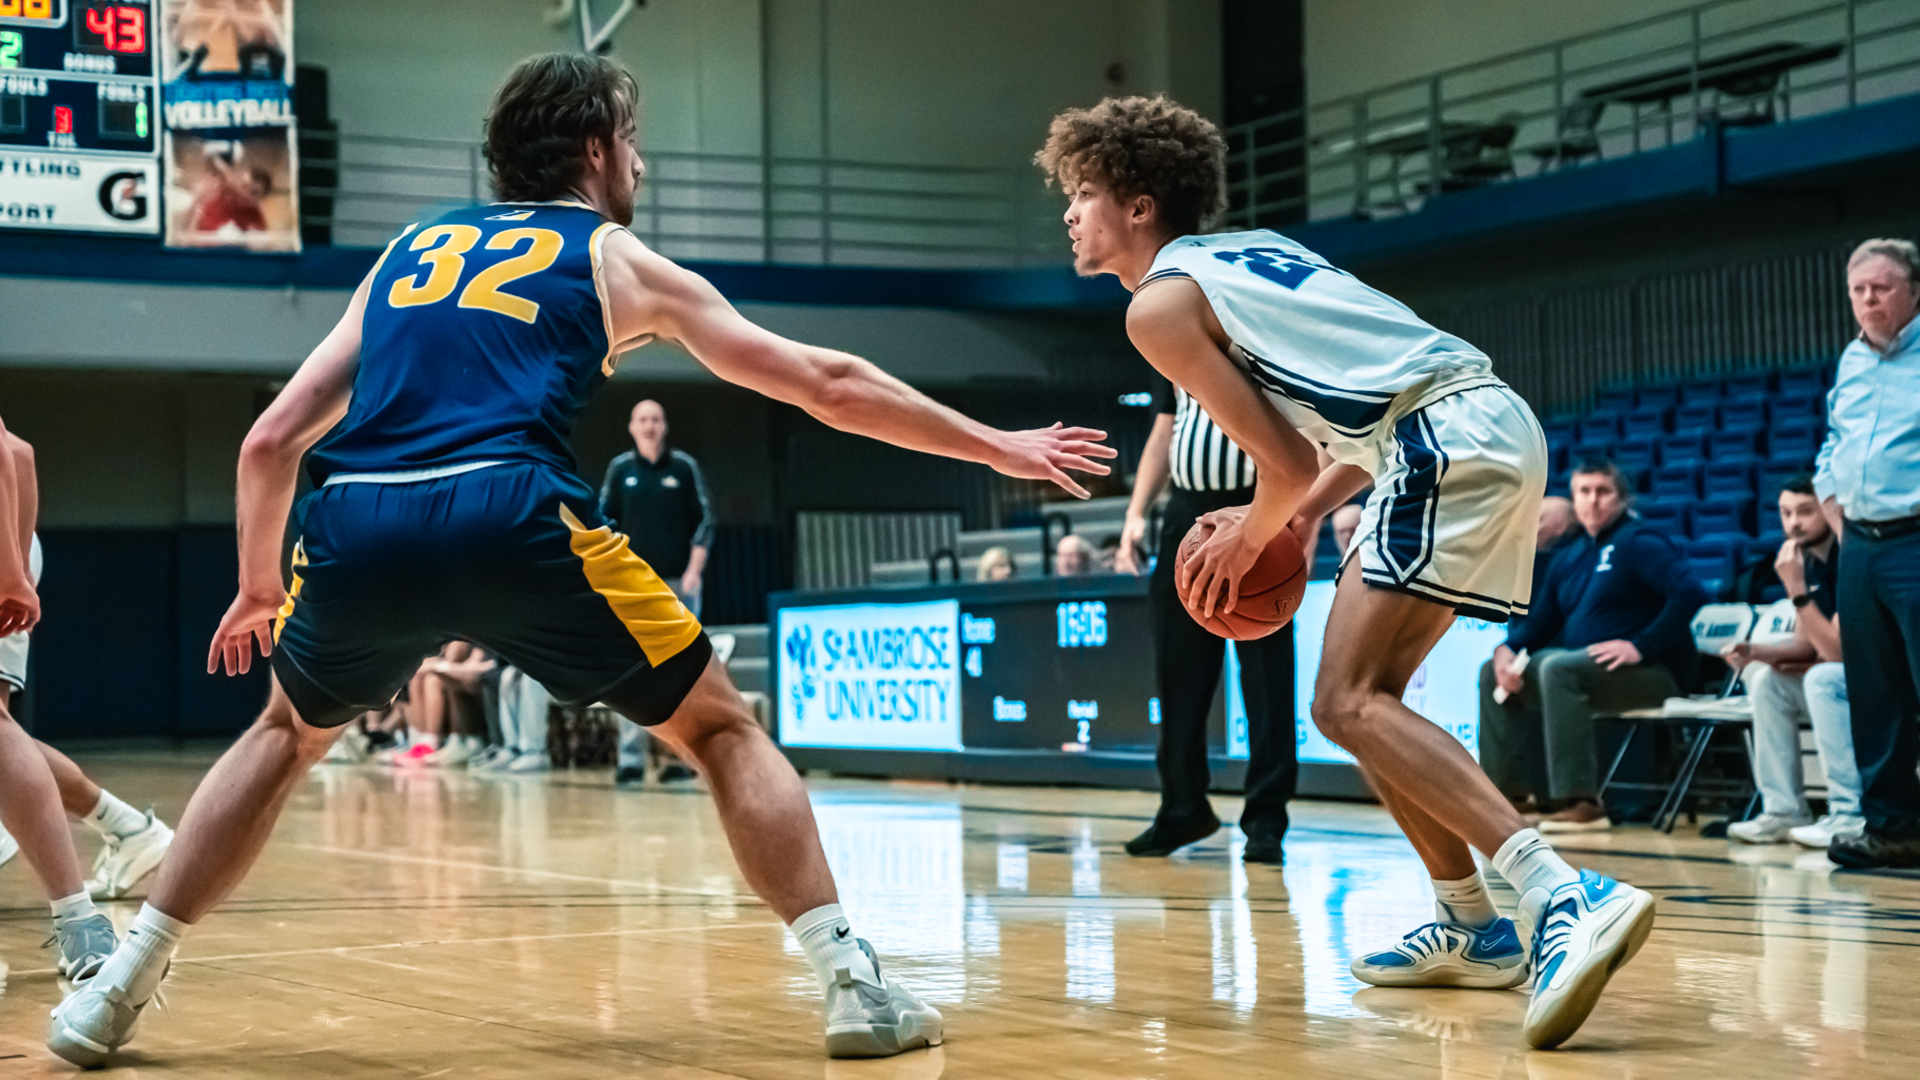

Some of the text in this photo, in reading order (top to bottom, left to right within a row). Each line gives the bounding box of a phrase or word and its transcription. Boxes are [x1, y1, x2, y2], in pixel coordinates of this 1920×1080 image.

[86, 6, 146, 53] 43
[164, 99, 293, 129] VOLLEYBALL
[388, 224, 564, 324] 32
[825, 678, 951, 723] UNIVERSITY
